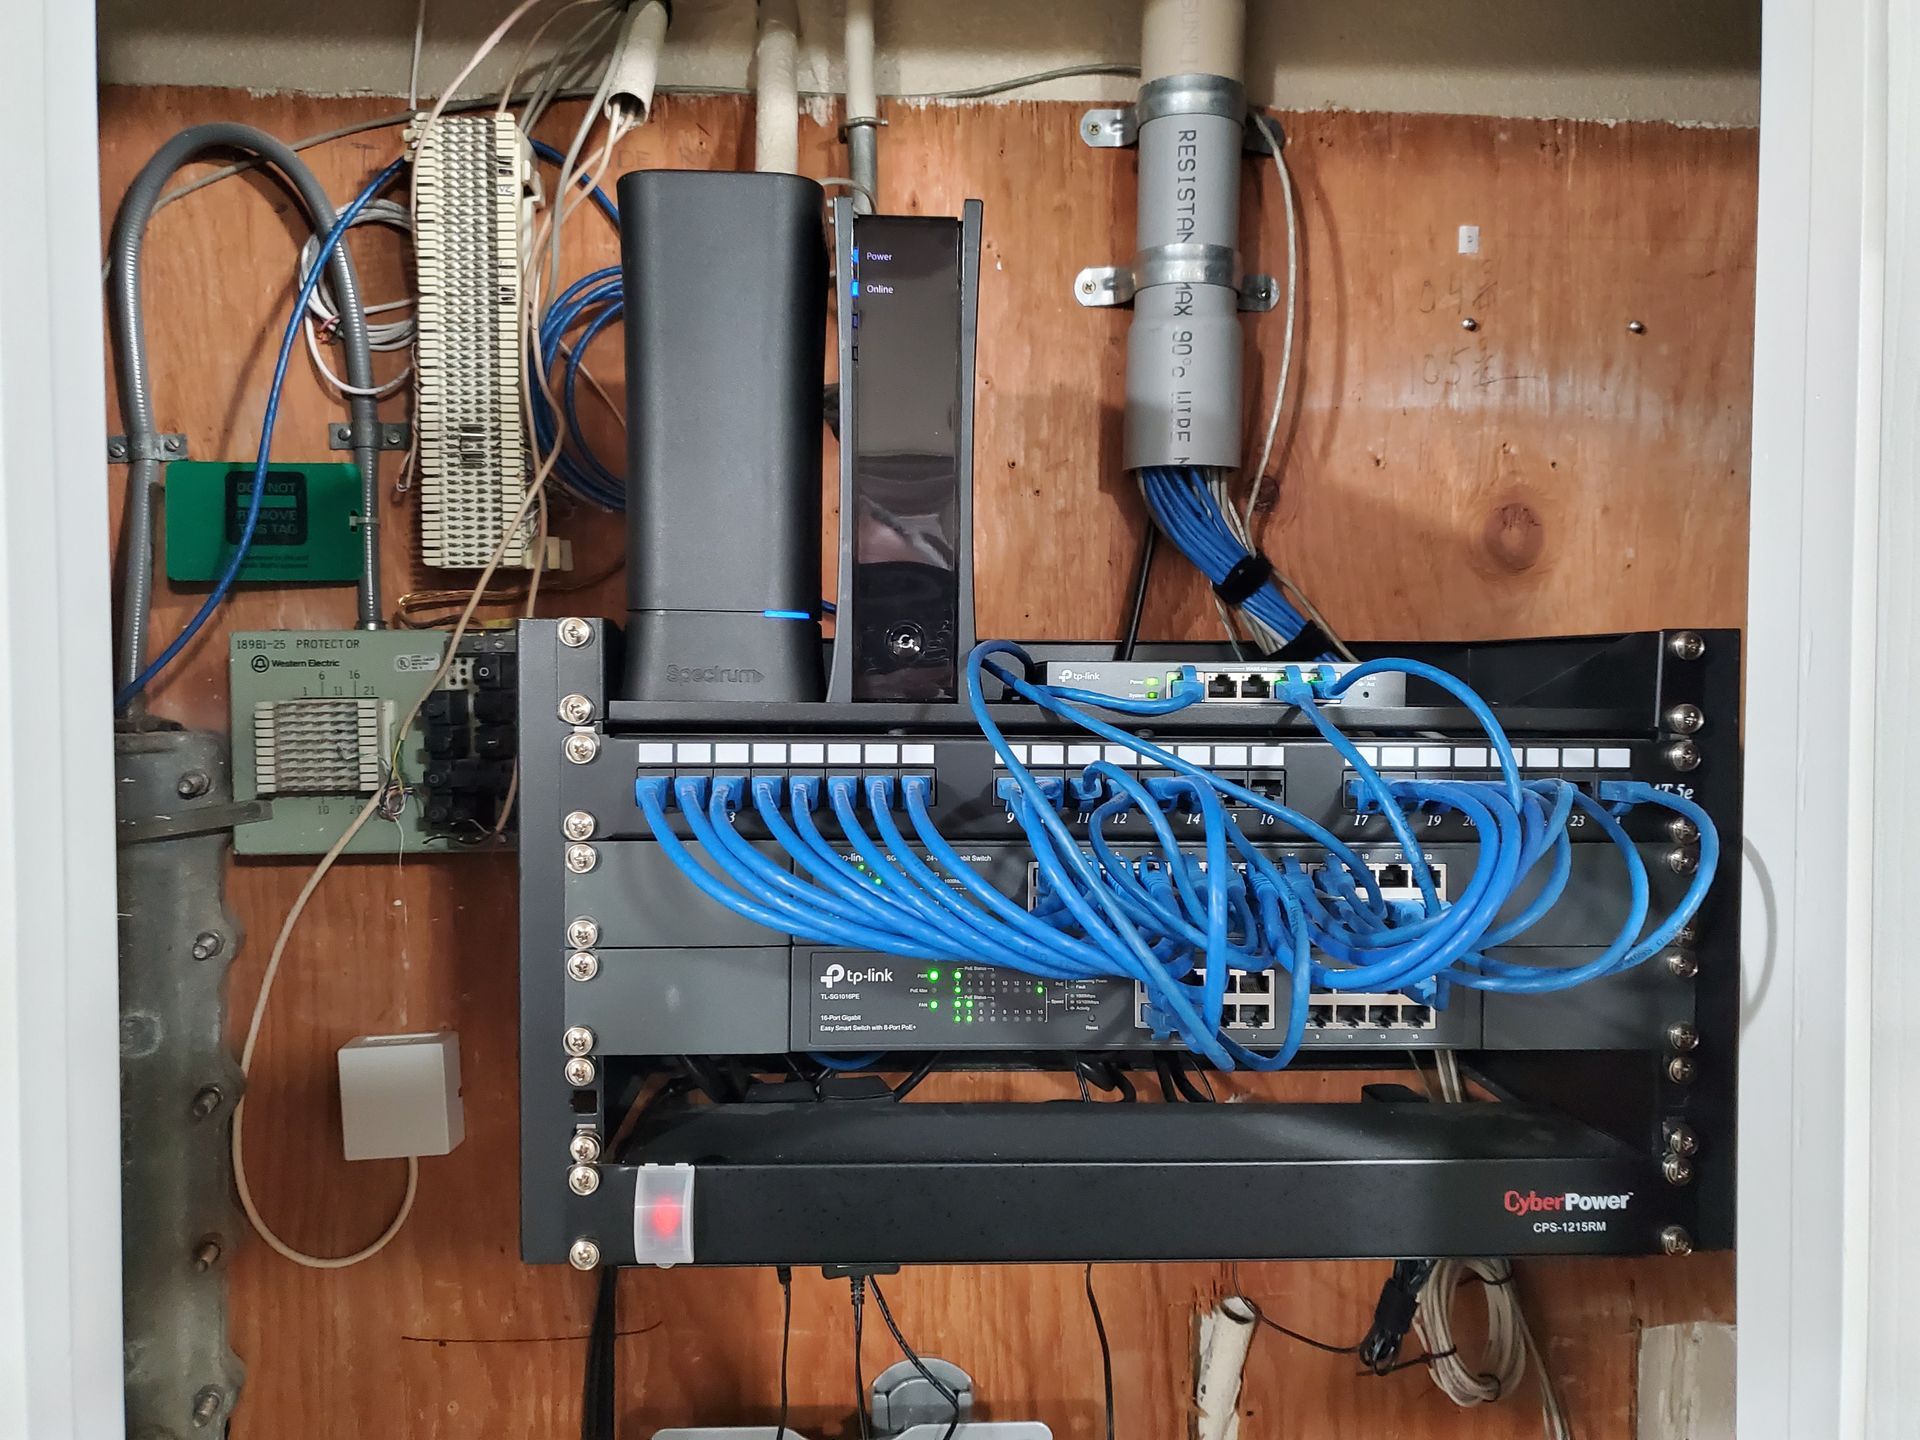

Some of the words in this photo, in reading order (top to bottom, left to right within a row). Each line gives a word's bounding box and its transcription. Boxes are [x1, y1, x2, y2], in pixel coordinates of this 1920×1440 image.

[866, 251, 893, 262] Power
[866, 284, 894, 294] Online
[269, 482, 297, 493] NOT
[237, 510, 297, 521] RMOVE
[271, 523, 298, 535] TAG
[296, 639, 360, 649] PROTECTOR
[271, 659, 307, 667] Western
[308, 659, 340, 667] Electric
[318, 671, 326, 681] 6
[350, 670, 361, 680] 16
[665, 664, 764, 686] Spectrum
[1073, 671, 1101, 681] tp-link
[334, 686, 343, 696] 11
[364, 686, 376, 696] 21
[729, 811, 736, 823] 3
[1006, 812, 1015, 824] 9
[1076, 812, 1090, 824] 11
[1113, 812, 1128, 824] 12
[1186, 813, 1201, 825] 14
[1260, 814, 1274, 825] 16
[1353, 814, 1369, 826] 17
[1426, 815, 1442, 826] 19
[1569, 816, 1586, 827] 23
[972, 854, 992, 862] Switch
[846, 968, 894, 985] tp-link
[842, 1014, 862, 1022] Gigabit
[820, 1025, 834, 1033] Easy
[1503, 1190, 1631, 1216] CyberPower
[1533, 1221, 1607, 1233] CPS-1215RM
